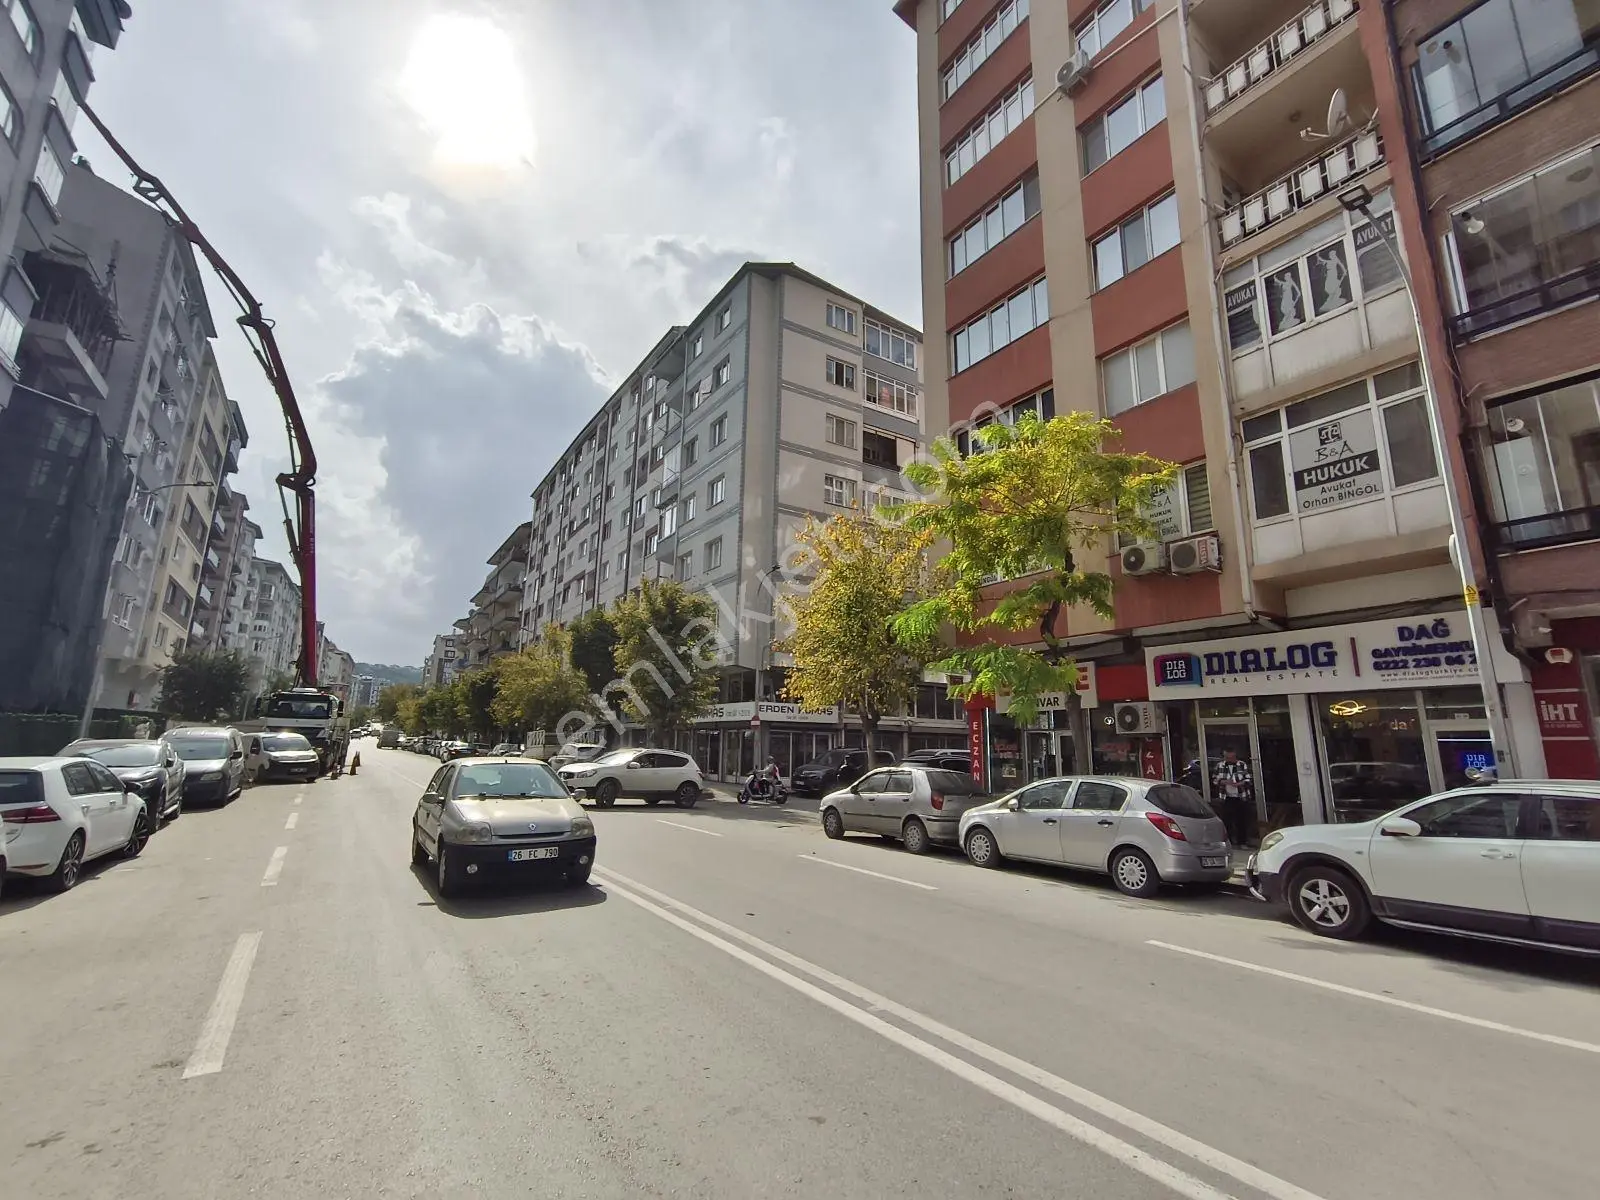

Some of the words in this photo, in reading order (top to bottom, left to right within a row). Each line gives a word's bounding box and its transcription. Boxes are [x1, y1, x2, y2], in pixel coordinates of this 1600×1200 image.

[1227, 285, 1255, 308] AVUKAT
[1303, 456, 1371, 485] HUKUK
[1320, 479, 1356, 495] Avukat
[1303, 496, 1335, 509] Orhan
[1397, 618, 1450, 641] DAĞ
[1166, 660, 1186, 670] DIA
[1203, 641, 1337, 676] DIALOG
[1167, 669, 1187, 679] LOG
[1210, 676, 1250, 685] REAL
[1266, 670, 1338, 681] ESTATE
[759, 704, 794, 713] ERDEN
[513, 851, 522, 860] 26
[528, 850, 538, 858] FC
